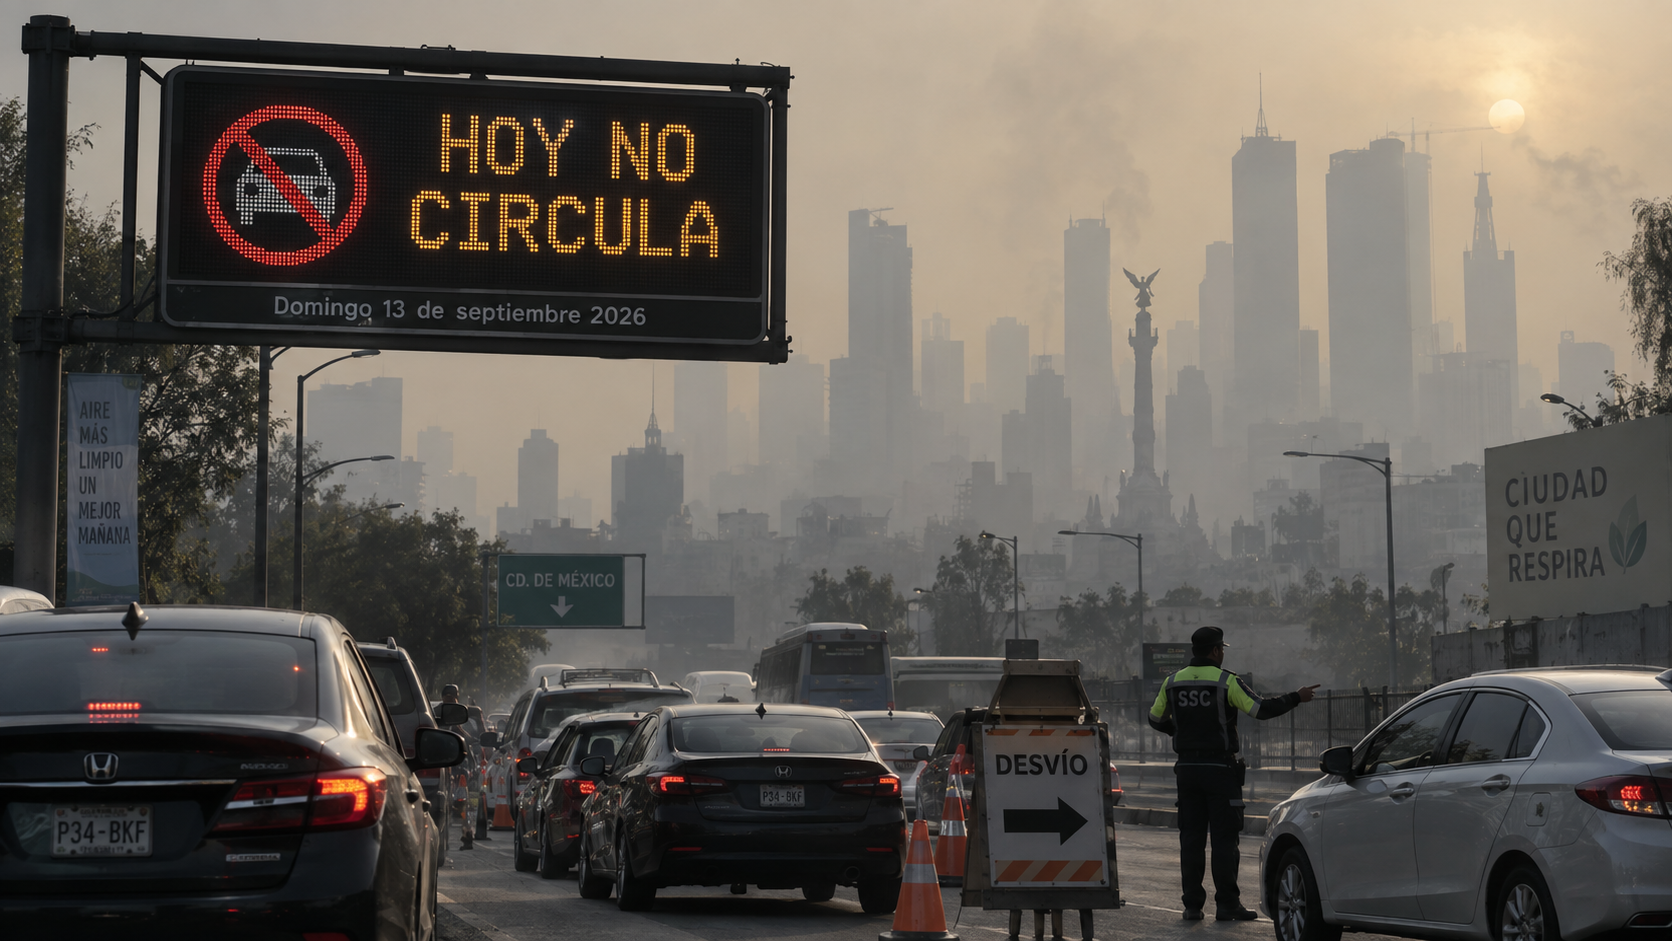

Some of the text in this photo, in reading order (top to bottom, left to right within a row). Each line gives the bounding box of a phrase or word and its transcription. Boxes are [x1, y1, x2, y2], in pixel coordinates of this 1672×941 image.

[441, 113, 695, 182] HOY NO
[410, 190, 719, 258] CIRCULA
[274, 296, 646, 327] Domingo 13 de septiembre 2026
[79, 400, 111, 420] AIRE
[79, 422, 108, 445] MÁS
[79, 451, 123, 470] LIMPIO
[79, 476, 97, 495] UN
[1505, 465, 1608, 508] CIUDAD
[78, 501, 121, 520] MEJOR
[78, 524, 131, 545] MAÑANA
[1506, 510, 1558, 549] QUE
[1508, 545, 1606, 583] RESPIRA
[505, 569, 615, 588] CD. DE MÉXICO
[1178, 689, 1211, 707] SSC
[995, 748, 1088, 776] DESVÍO
[57, 820, 147, 844] P34-BKF
